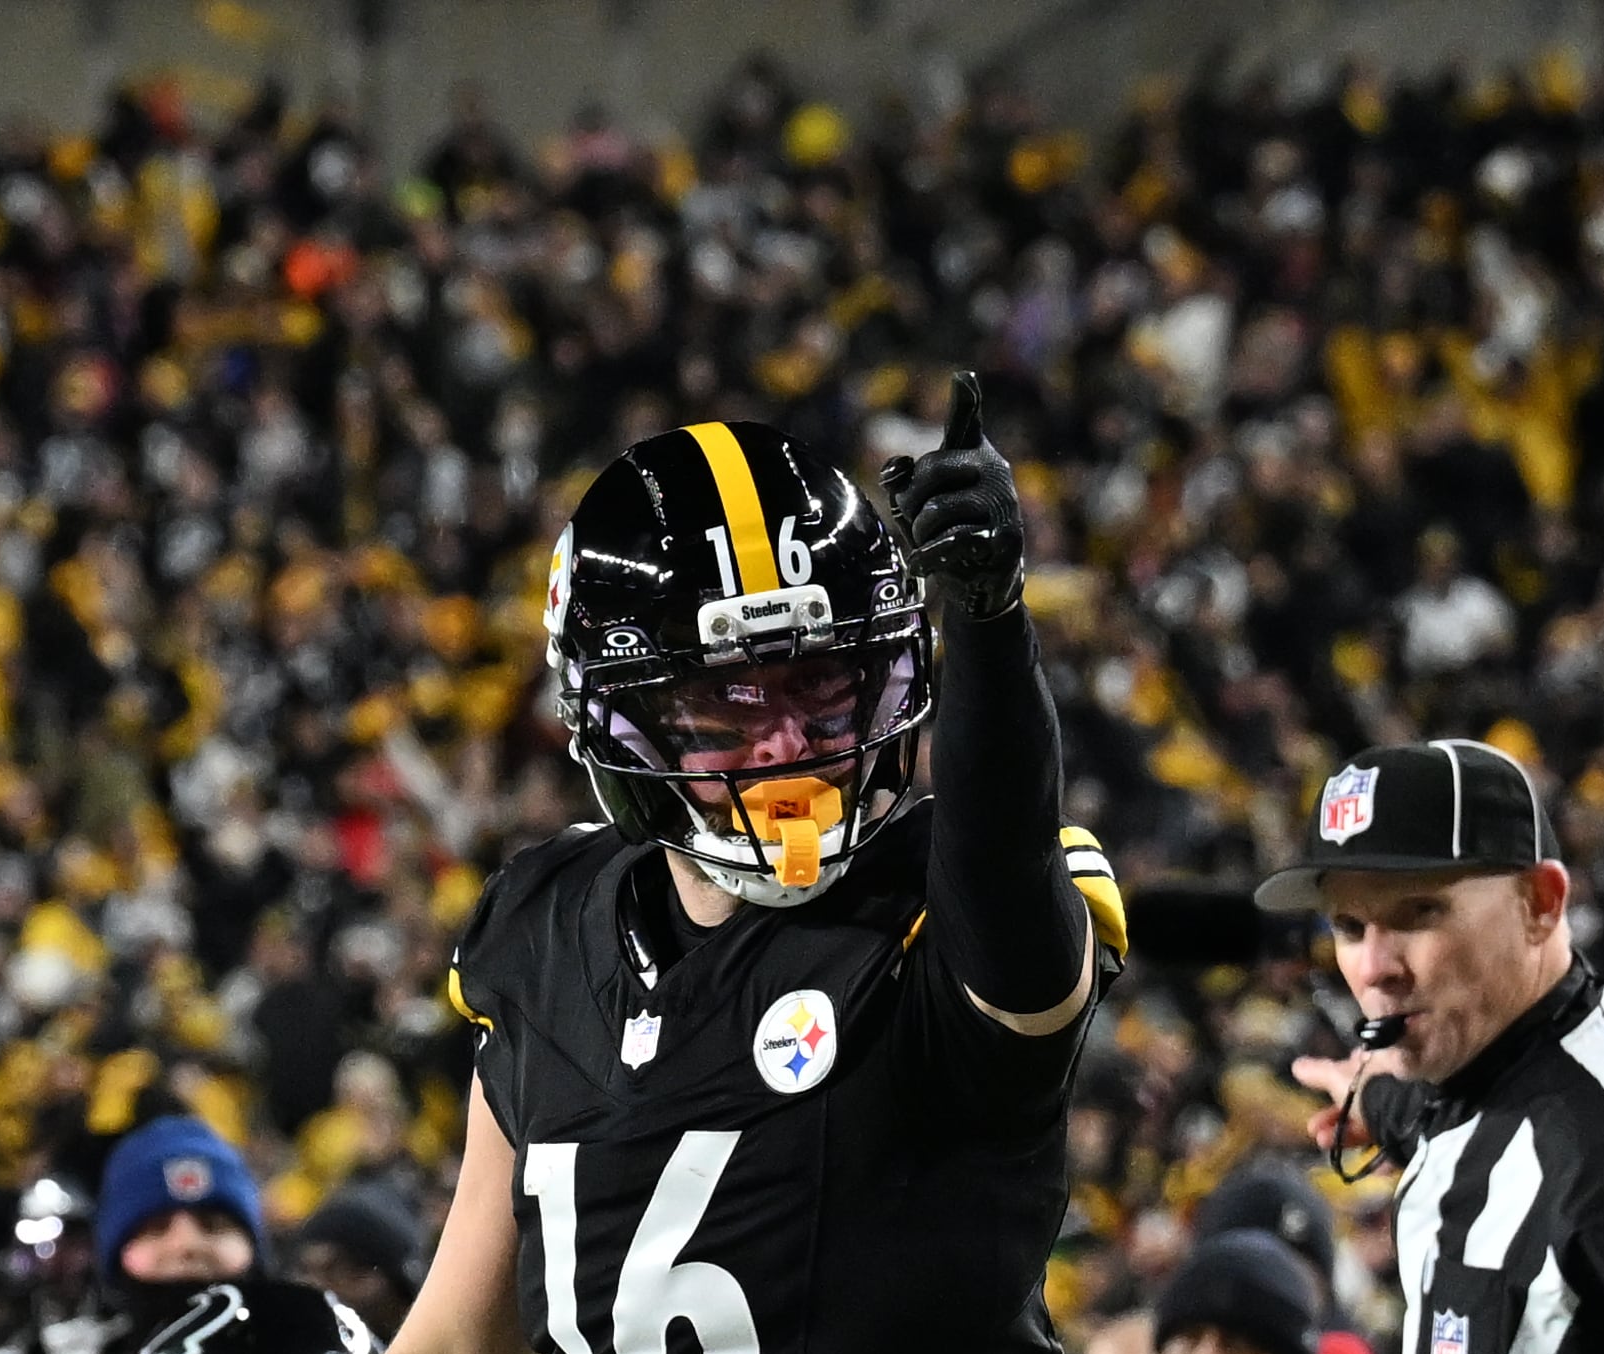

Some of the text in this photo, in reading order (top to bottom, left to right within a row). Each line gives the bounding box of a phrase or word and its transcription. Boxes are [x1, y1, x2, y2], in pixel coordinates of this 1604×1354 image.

[741, 600, 791, 621] Steelers
[601, 647, 648, 657] OAKLEY
[762, 1035, 798, 1051] Steelers
